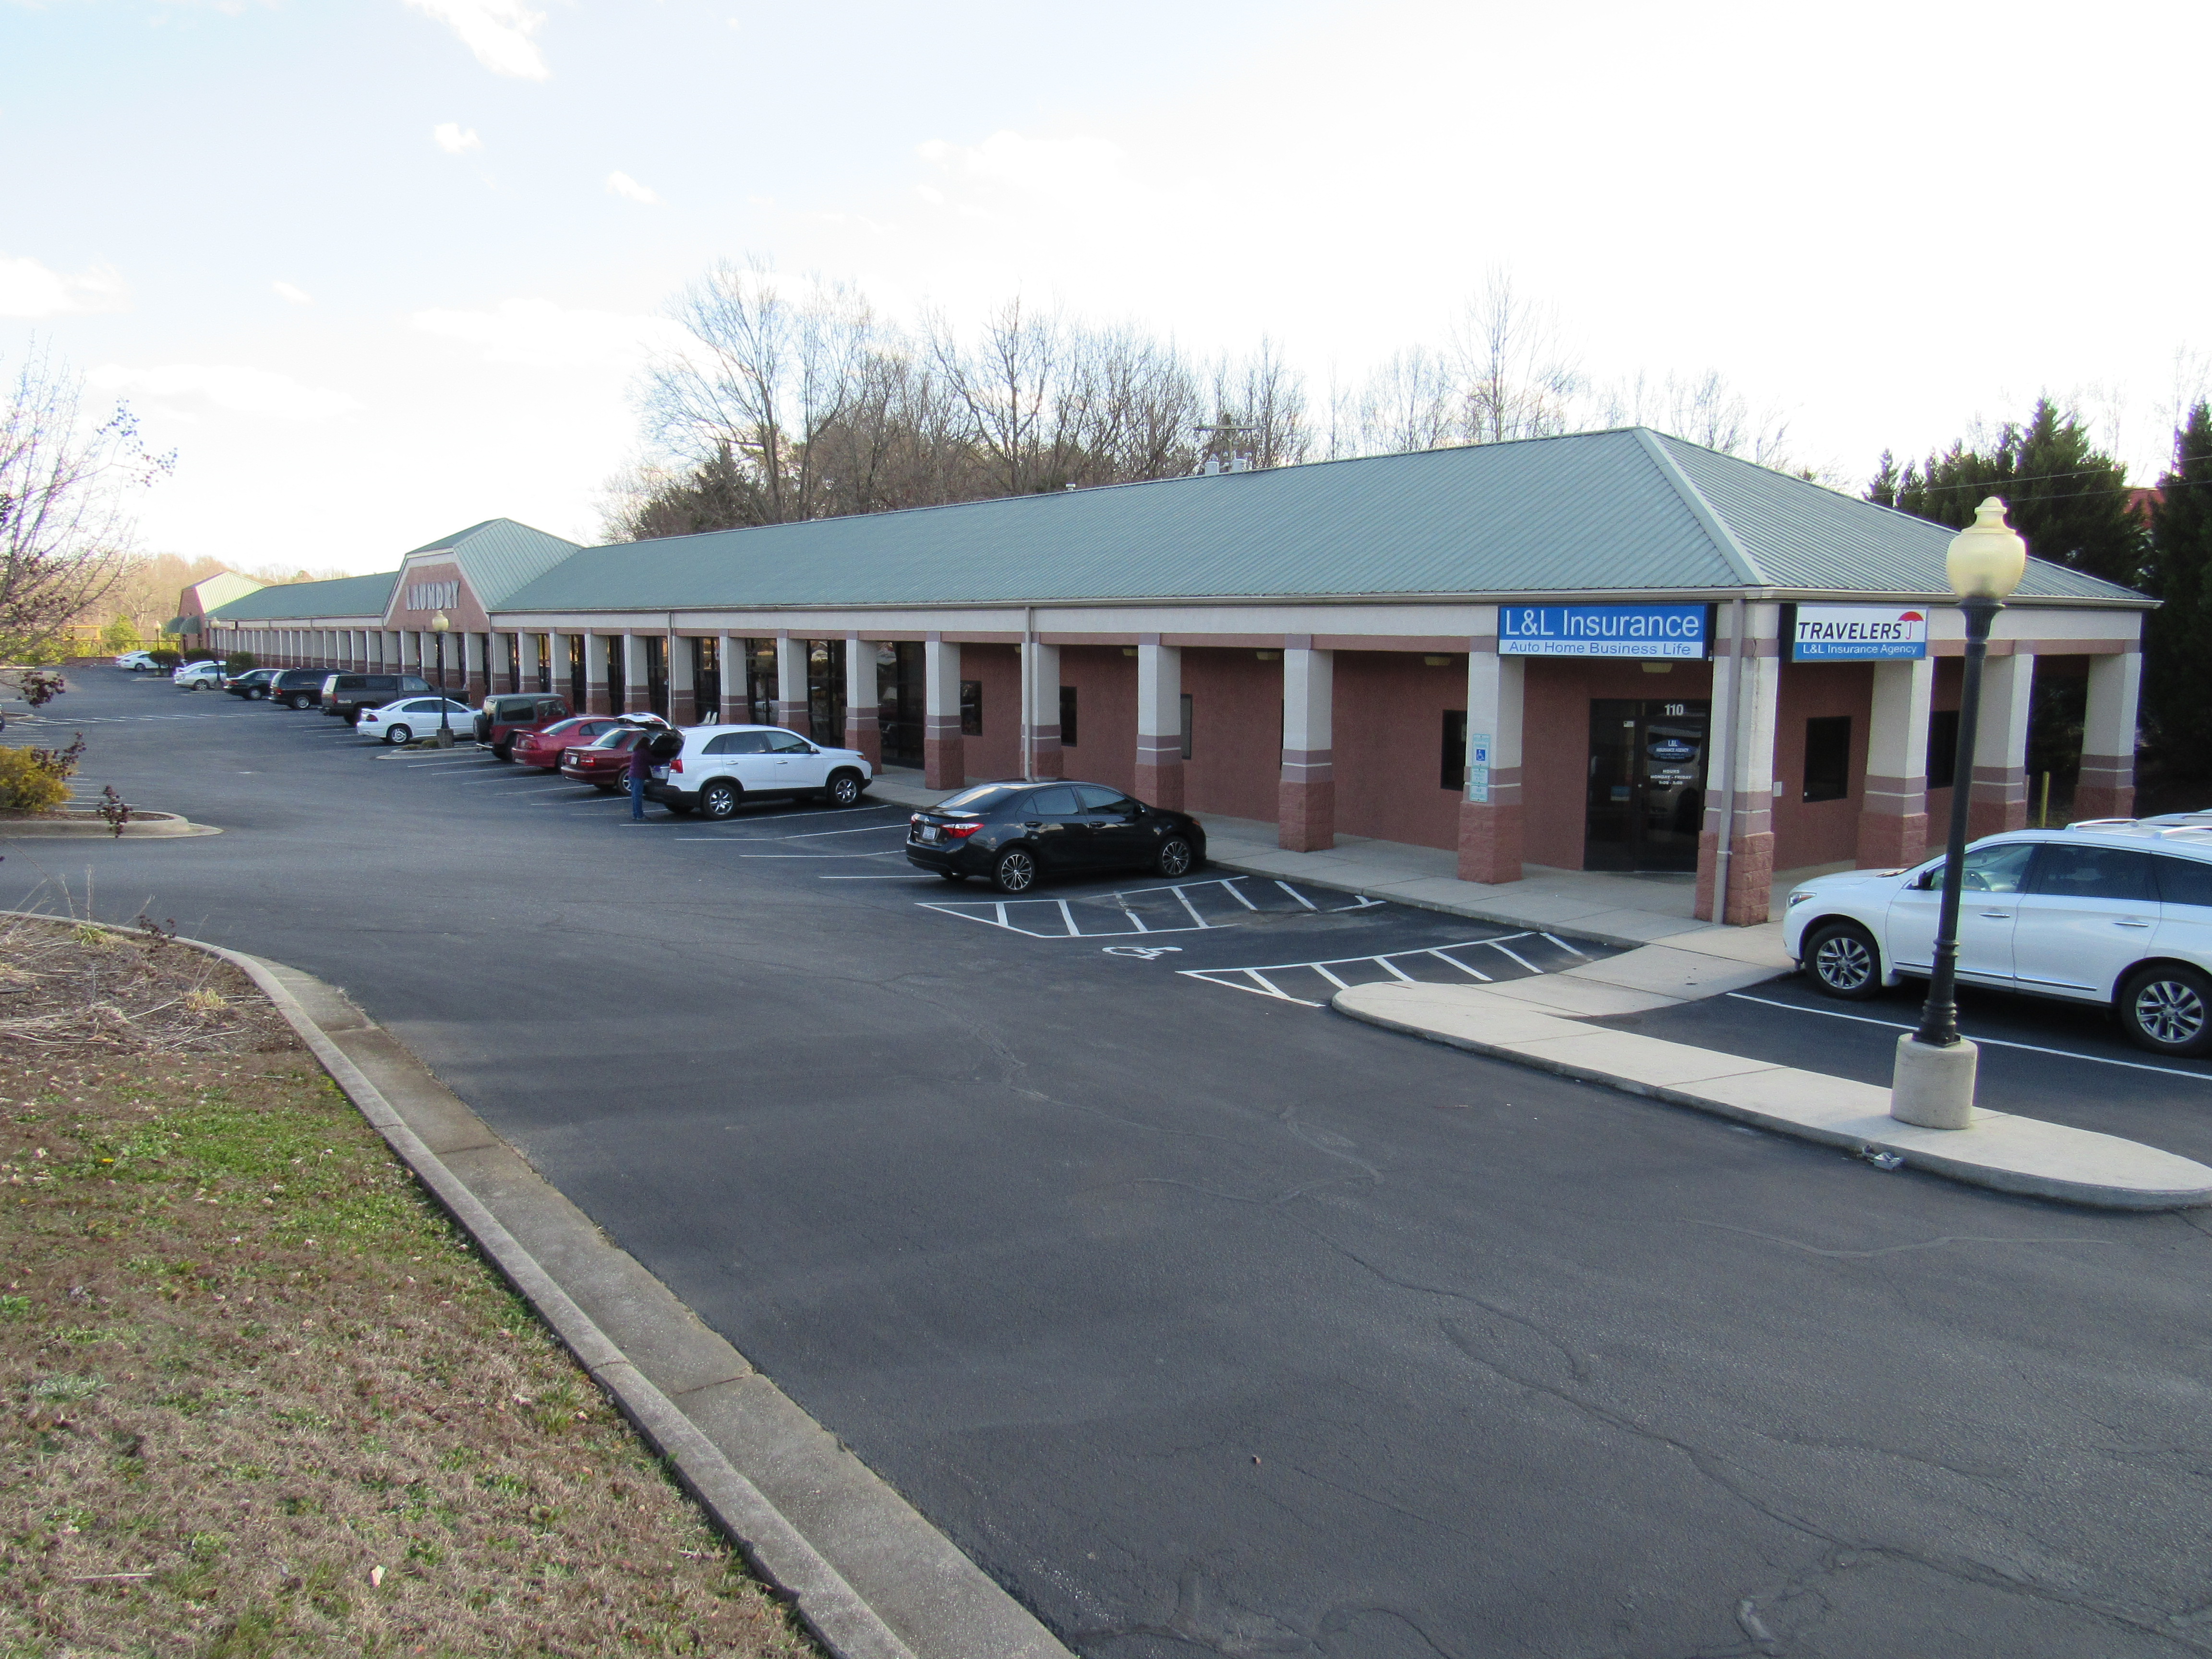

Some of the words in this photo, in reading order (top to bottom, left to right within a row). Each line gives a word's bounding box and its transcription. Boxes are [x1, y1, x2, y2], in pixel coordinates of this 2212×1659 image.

[406, 580, 459, 610] LAUNDRY
[1506, 609, 1554, 636] L&L
[1563, 609, 1699, 637] Insurance
[1798, 622, 1902, 639] TRAVELERS
[1509, 641, 1540, 652] Auto
[1544, 641, 1585, 653] Home
[1590, 642, 1658, 655] Business
[1663, 643, 1691, 655] Life
[1803, 644, 1824, 654] L&L
[1827, 644, 1877, 654] Insurance
[1880, 644, 1917, 655] Agency
[1664, 703, 1684, 716] 110
